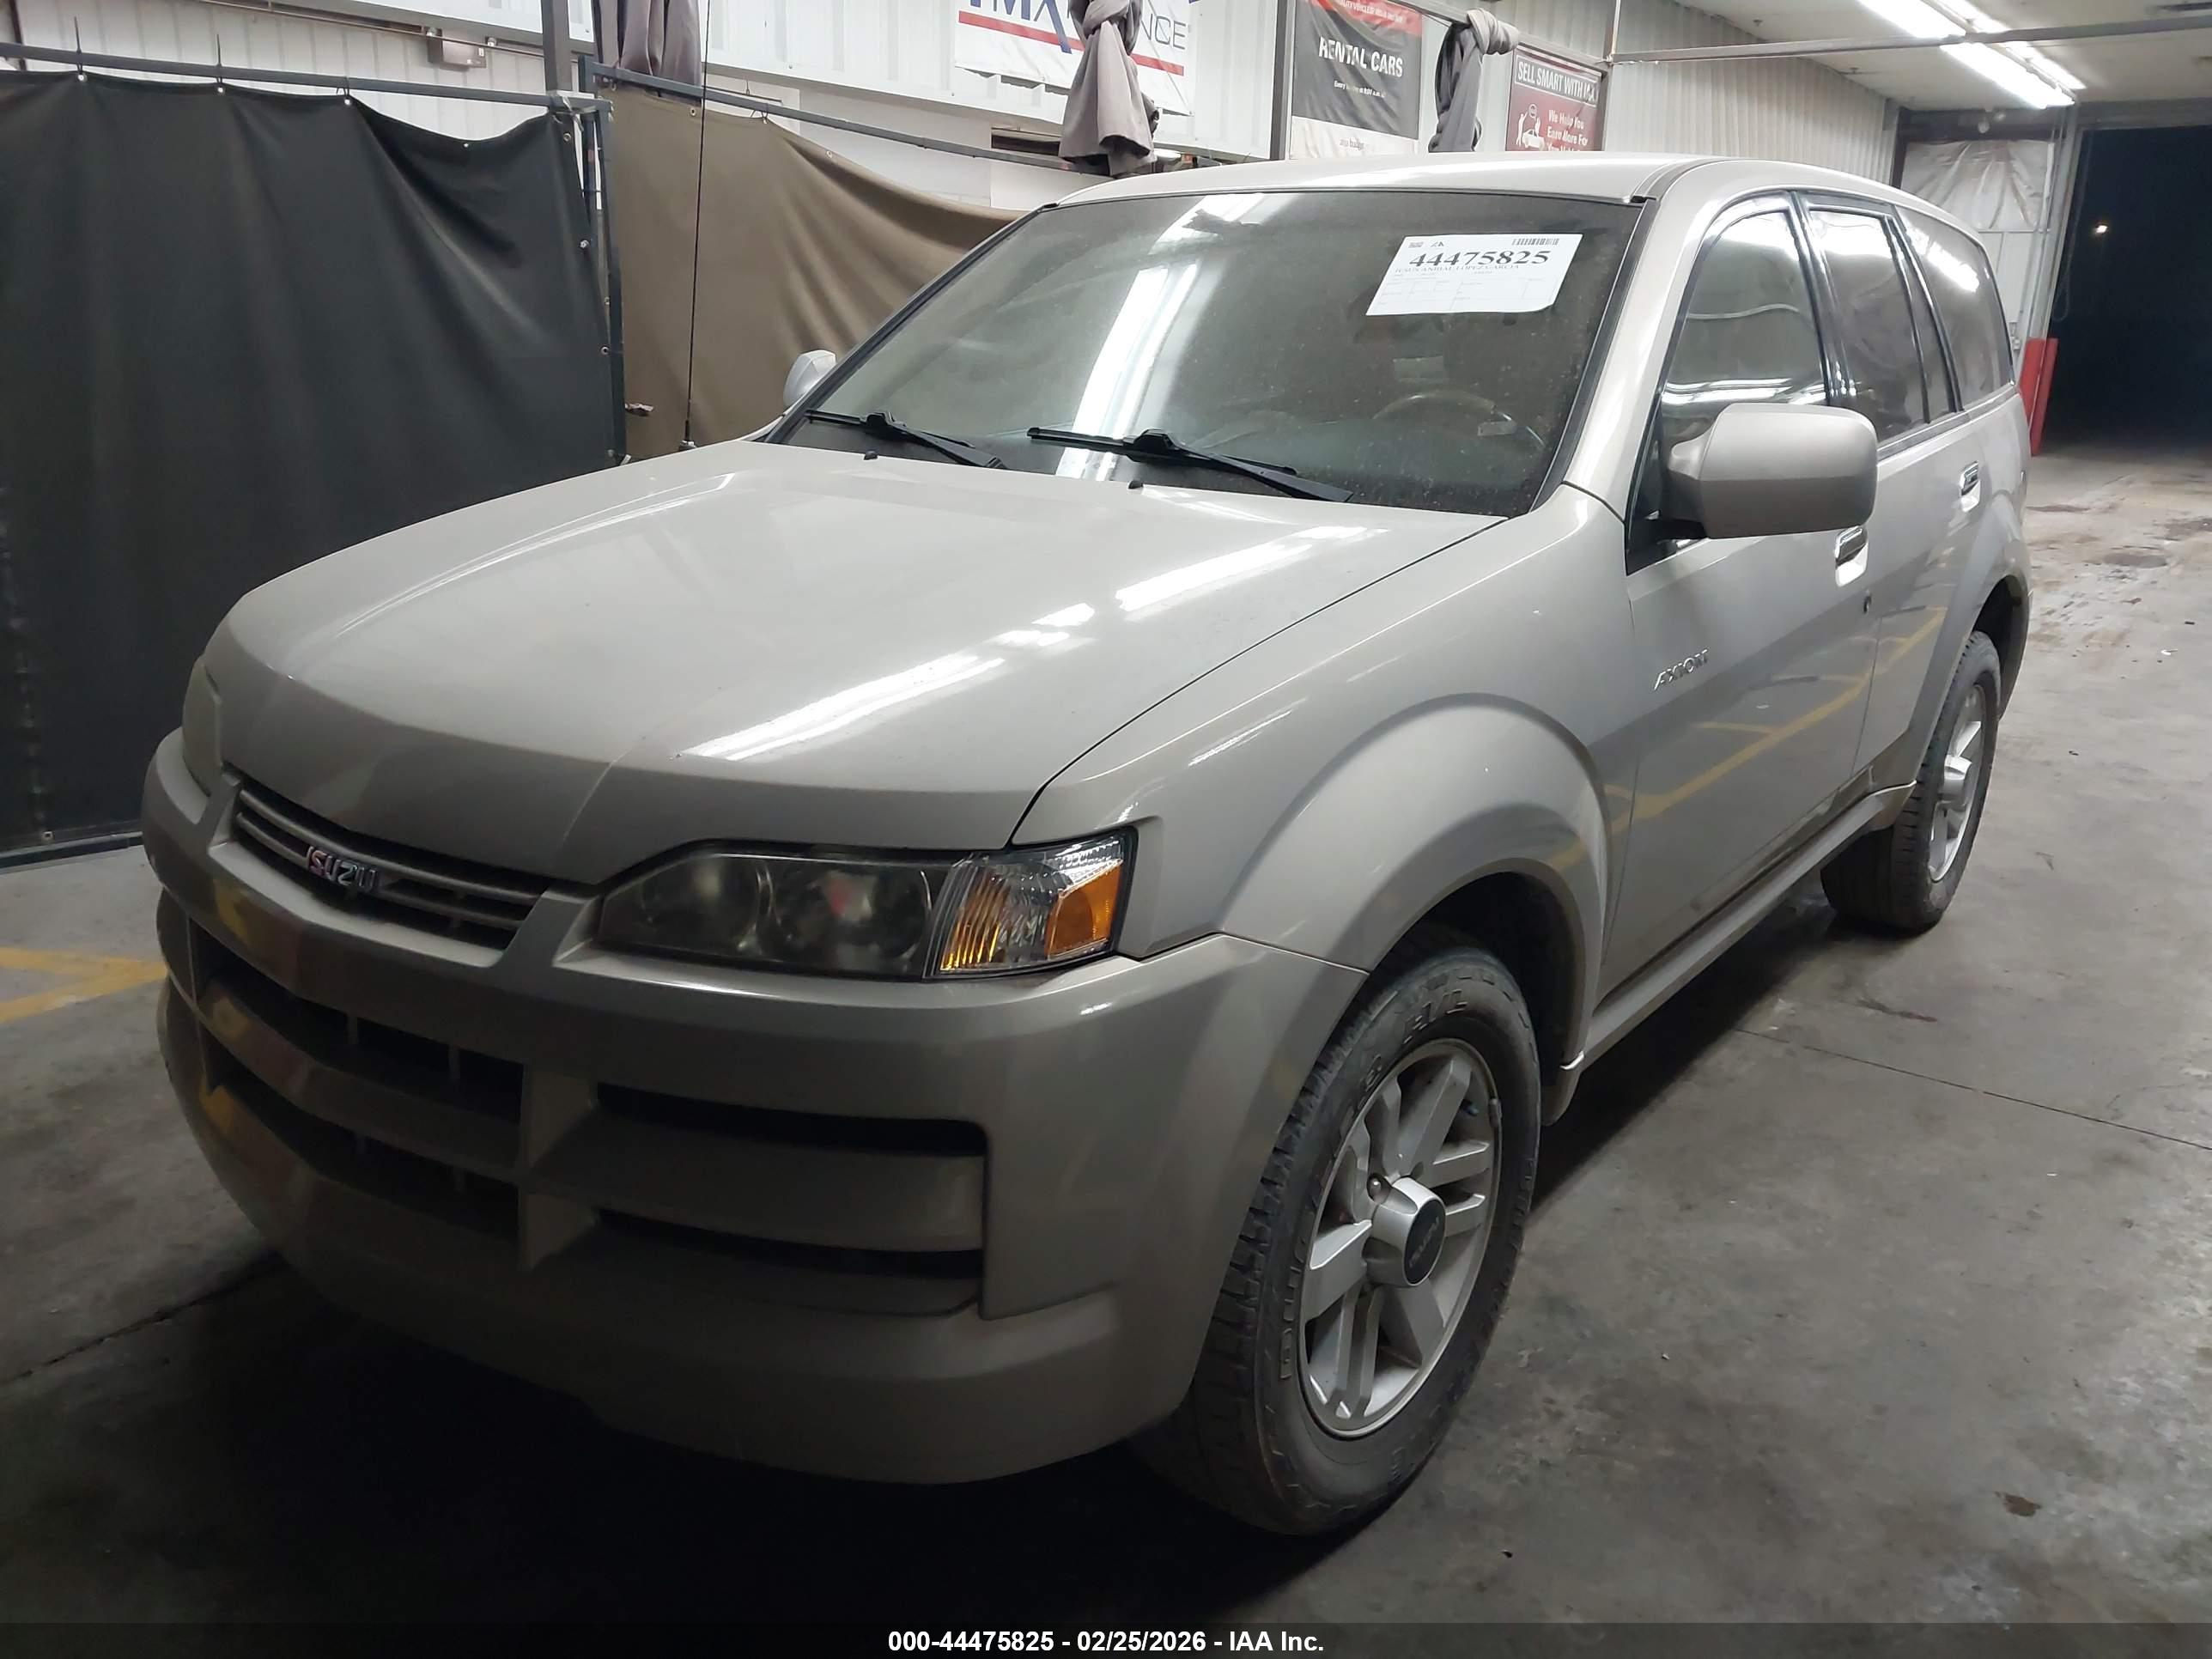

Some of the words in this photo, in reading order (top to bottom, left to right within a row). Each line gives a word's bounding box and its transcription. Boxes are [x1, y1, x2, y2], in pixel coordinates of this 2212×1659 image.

[1318, 36, 1367, 69] RENTAL
[1370, 52, 1403, 77] CARS
[1517, 61, 1535, 84] SELL
[1536, 67, 1564, 92] SMART
[1564, 76, 1583, 98] WITH
[1548, 109, 1559, 124] We
[1574, 116, 1585, 130] You
[1547, 125, 1561, 140] Earn
[1562, 130, 1578, 143] More
[1578, 134, 1588, 146] For
[1408, 250, 1552, 267] 44475825
[307, 845, 376, 893] ISUZU
